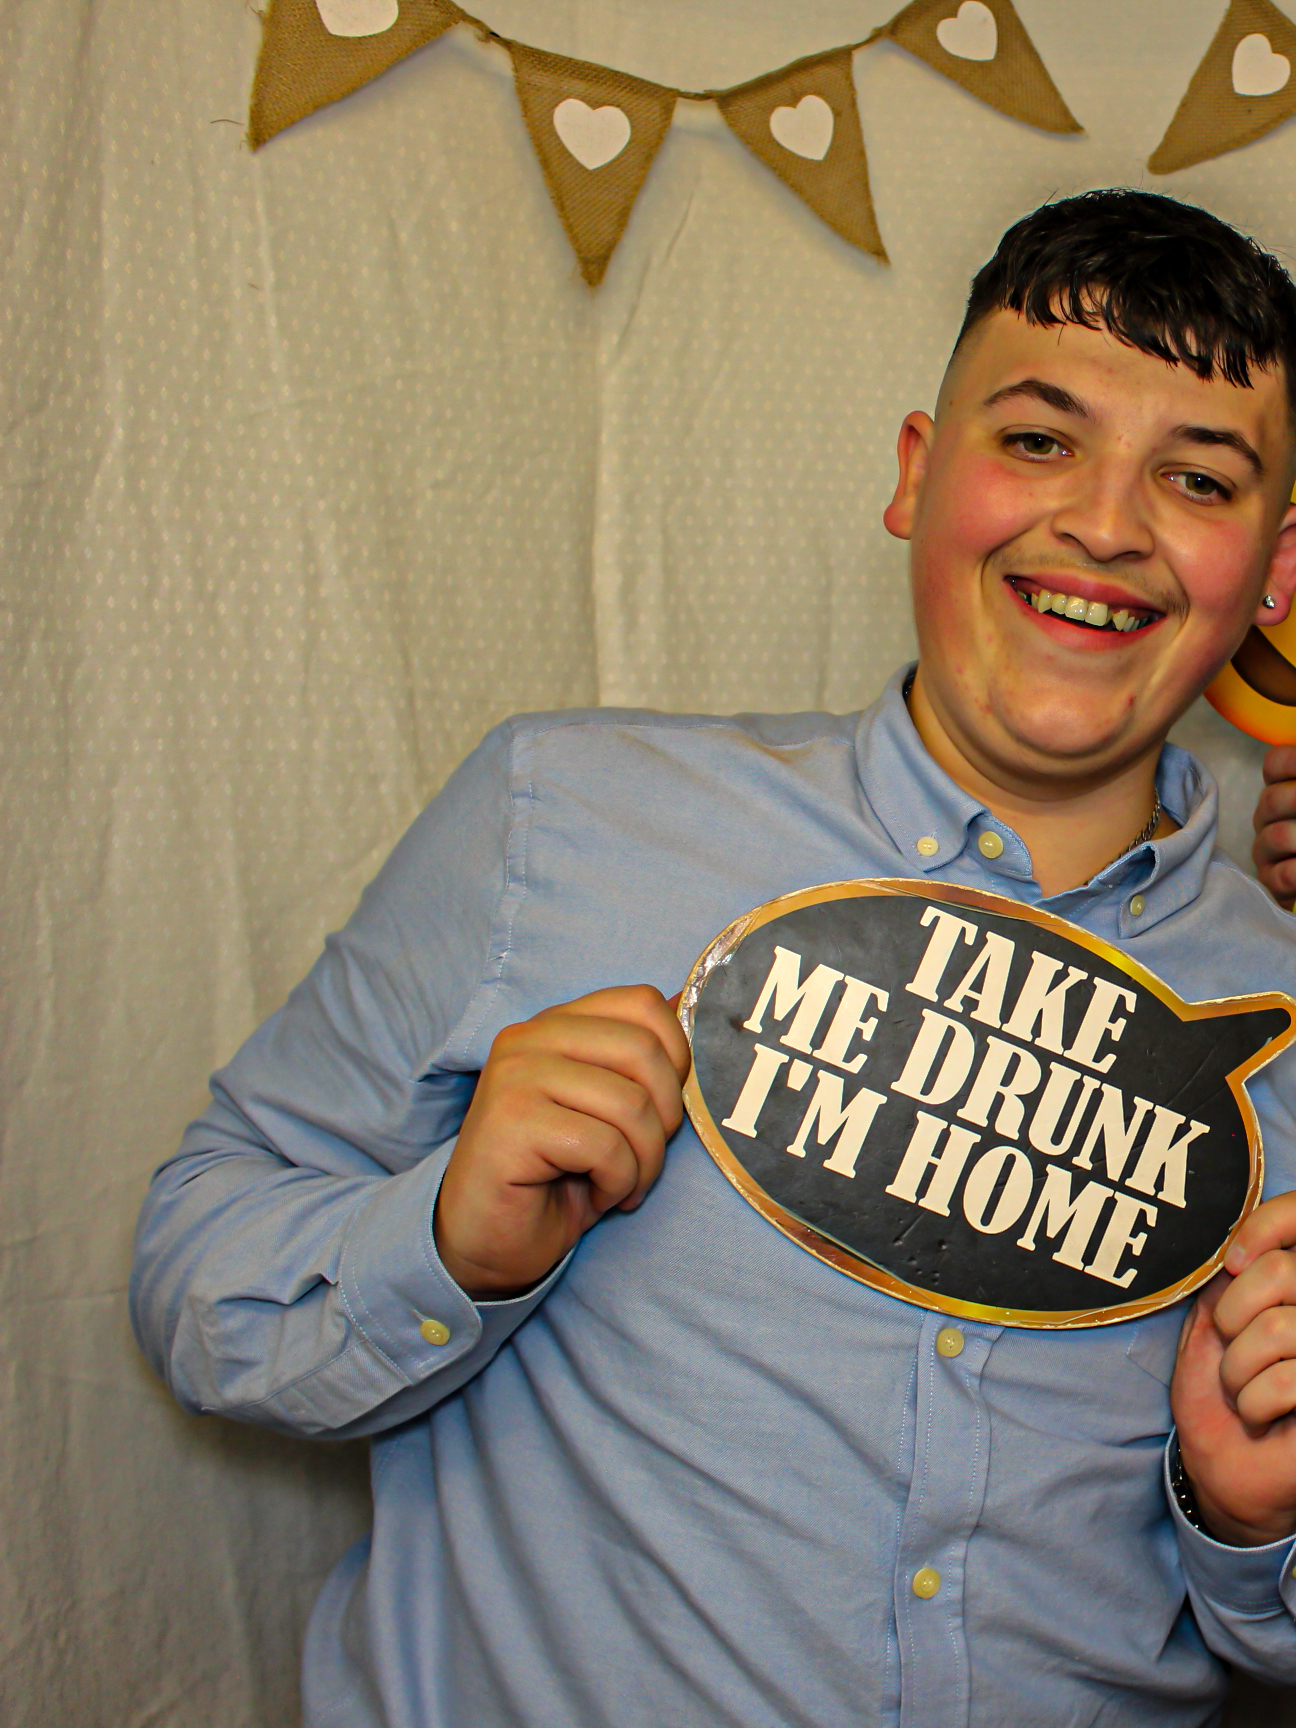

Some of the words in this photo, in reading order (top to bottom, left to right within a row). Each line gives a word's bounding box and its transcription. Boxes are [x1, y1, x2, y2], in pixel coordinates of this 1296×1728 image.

[743, 945, 890, 1073] ME
[890, 1008, 1211, 1208] DRUNK
[905, 905, 1137, 1074] TAKE
[721, 1043, 888, 1178] I'M
[885, 1111, 1158, 1289] HOME
